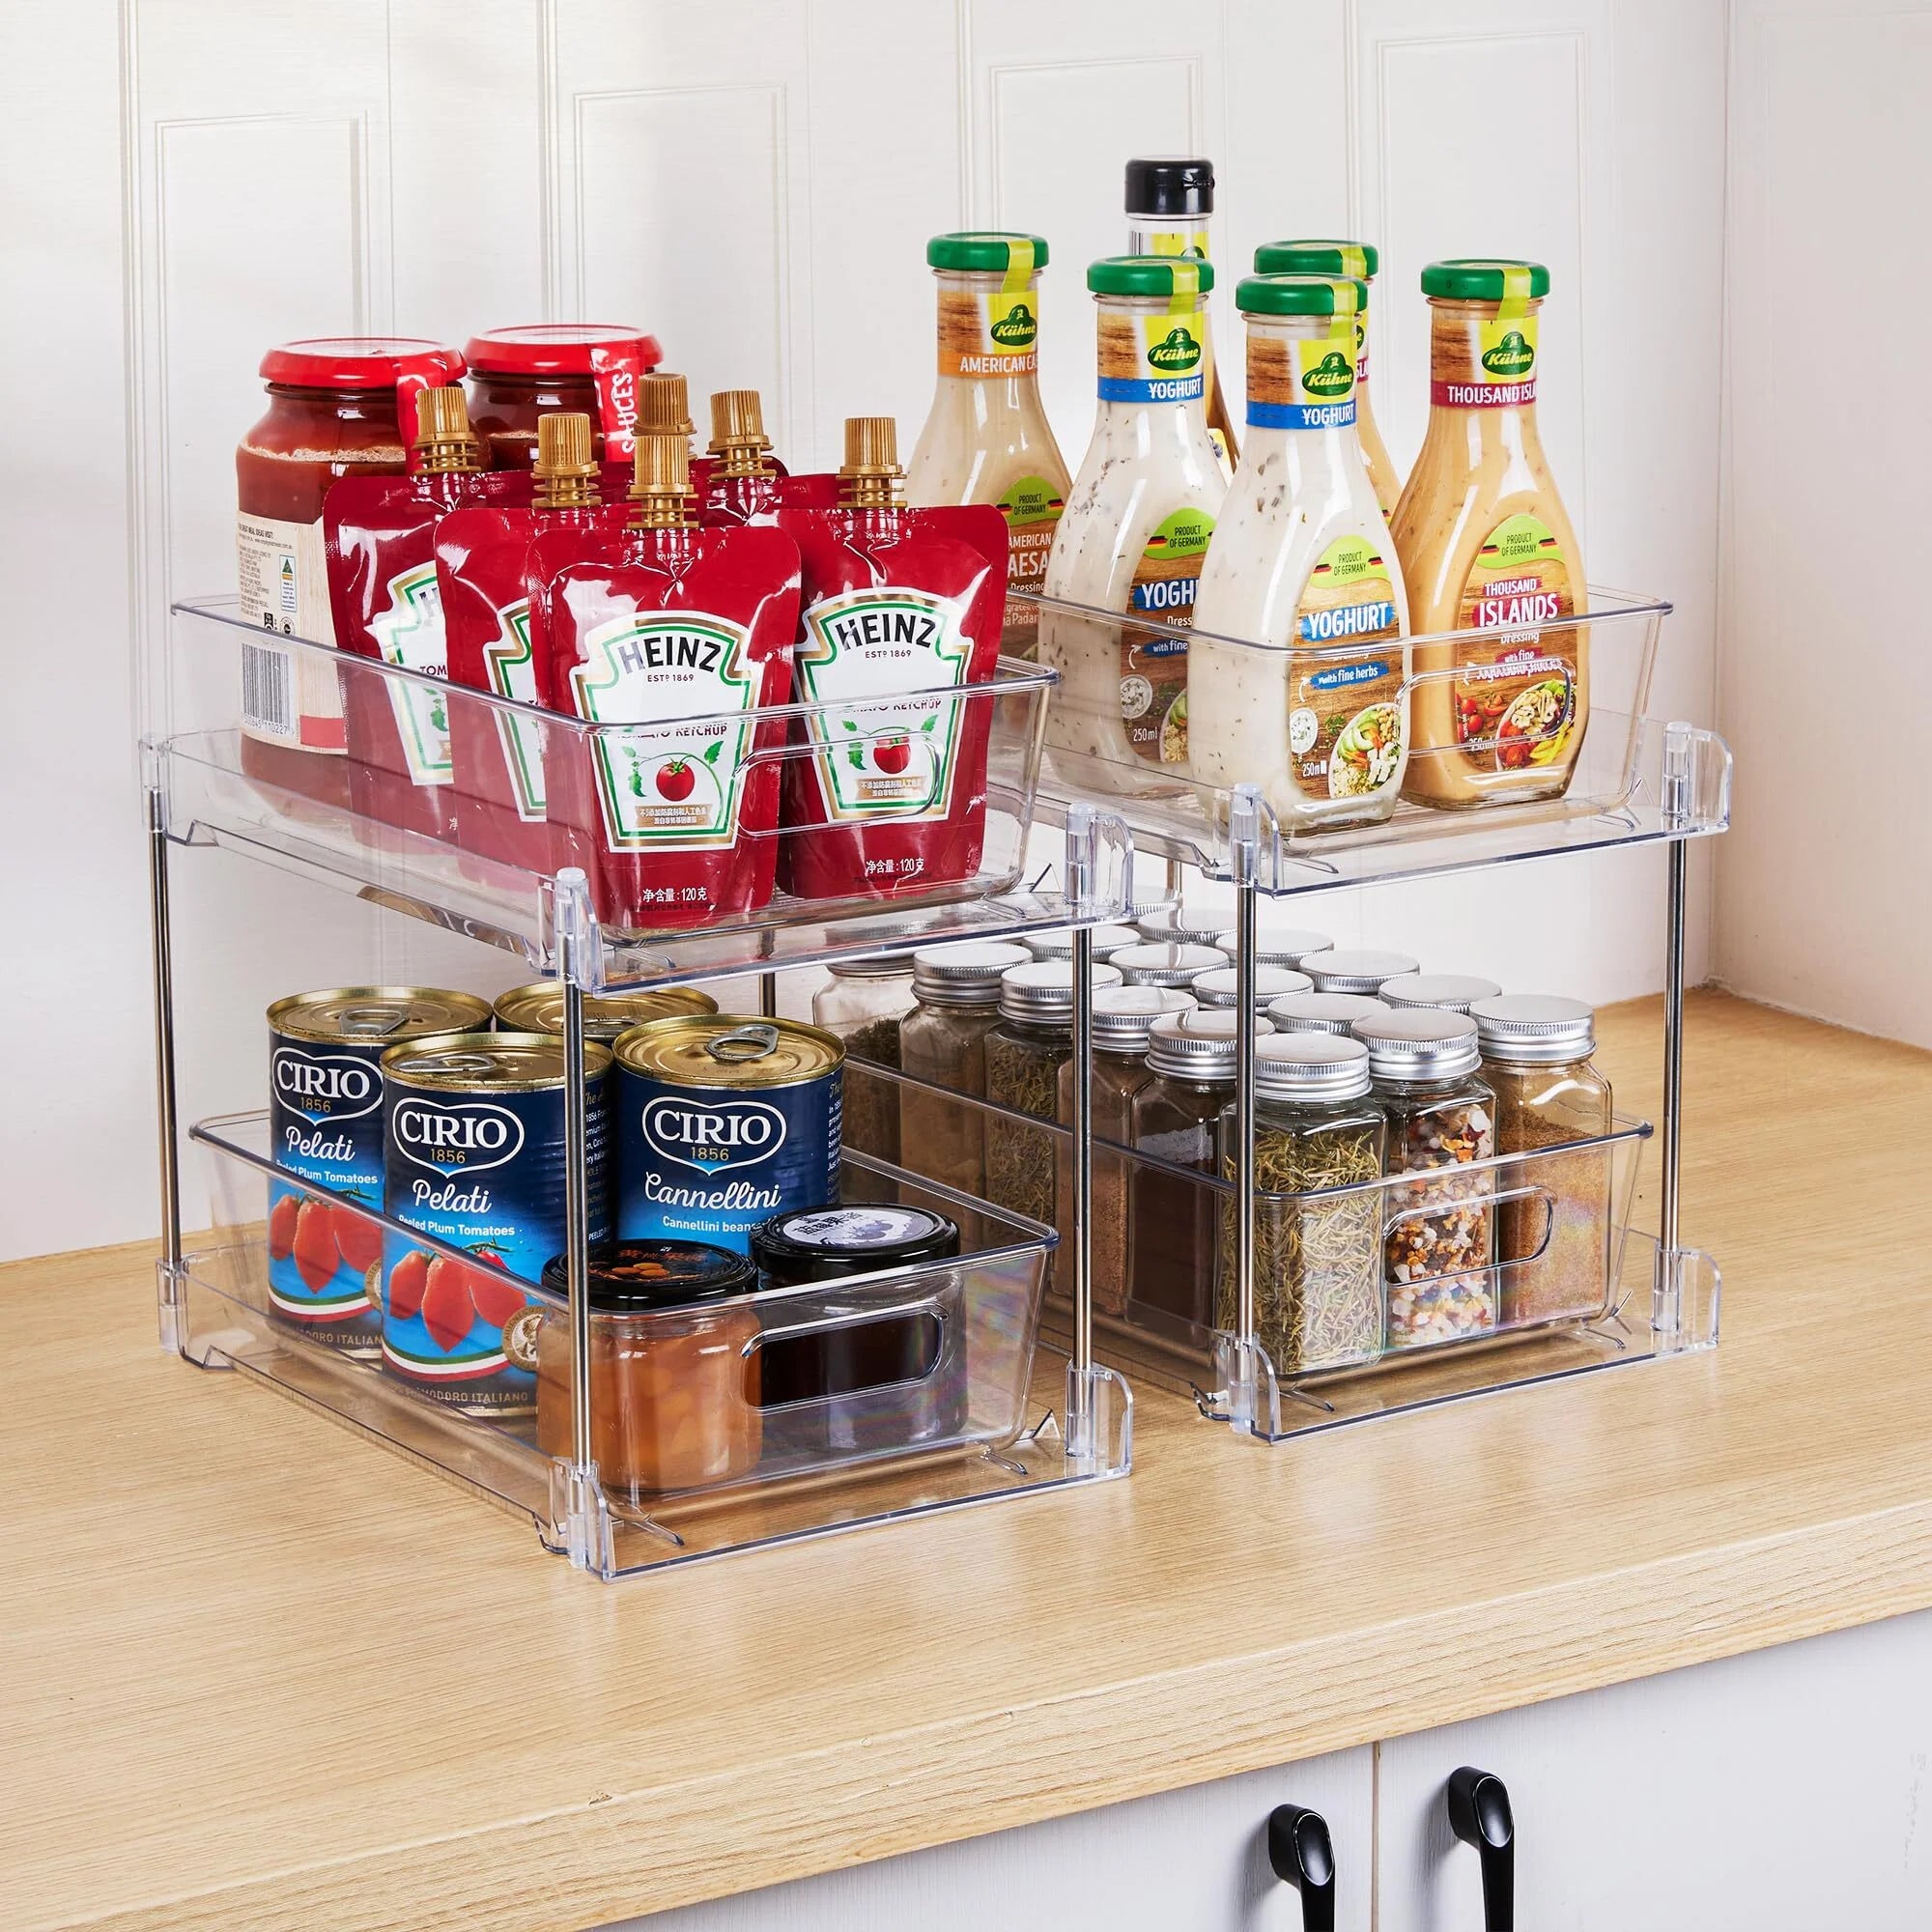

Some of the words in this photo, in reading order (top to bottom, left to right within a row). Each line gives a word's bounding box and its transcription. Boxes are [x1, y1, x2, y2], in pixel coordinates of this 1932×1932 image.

[1153, 346, 1199, 362] Kühne
[1488, 352, 1533, 366] Kühne
[960, 355, 1025, 373] AMERICAN
[1148, 376, 1202, 399] YOGHURT
[1308, 372, 1352, 387] Kühne
[1447, 384, 1519, 404] THOUSAND
[1301, 403, 1355, 426] YOGHURT
[1018, 494, 1042, 504] PRODUCT
[1014, 505, 1021, 516] OF
[1021, 503, 1046, 516] GERMANY
[1174, 525, 1202, 536] PRODUCT
[1507, 532, 1532, 544] PRODUCT
[1169, 539, 1177, 549] OF
[1178, 536, 1206, 548] GERMANY
[1501, 547, 1509, 556] OF
[1509, 545, 1537, 556] GERMANY
[1338, 552, 1363, 563] PRODUCT
[1333, 565, 1342, 576] OF
[1342, 562, 1367, 576] GERMANY
[1484, 578, 1537, 597] THOUSAND
[1479, 592, 1558, 628] ISLANDS
[1307, 602, 1389, 639] YOGHURT
[836, 613, 936, 651] HEINZ
[890, 649, 912, 658] 1869
[1152, 642, 1169, 653] with
[1170, 639, 1188, 652] fine
[618, 636, 723, 674] HEINZ
[1519, 649, 1535, 661] fine
[672, 673, 695, 682] 1869
[1338, 668, 1354, 683] fine
[1355, 665, 1378, 679] herbs
[642, 887, 707, 903] 净含量:120克
[277, 1059, 370, 1099] CIRIO
[300, 1096, 331, 1114] 1856
[401, 1110, 507, 1149] CIRIO
[654, 1109, 772, 1146] CIRIO
[286, 1125, 356, 1162] Pelati
[431, 1148, 466, 1164] 1856
[691, 1146, 729, 1161] 1856
[298, 1166, 322, 1180] Plum
[324, 1170, 379, 1184] Tomatoes
[412, 1179, 493, 1213] Pelati
[645, 1171, 782, 1210] Cannellini
[428, 1220, 455, 1235] Plum
[458, 1224, 516, 1236] Tomatoes
[663, 1215, 720, 1232] Cannellini
[472, 1392, 528, 1404] ITALIANO
